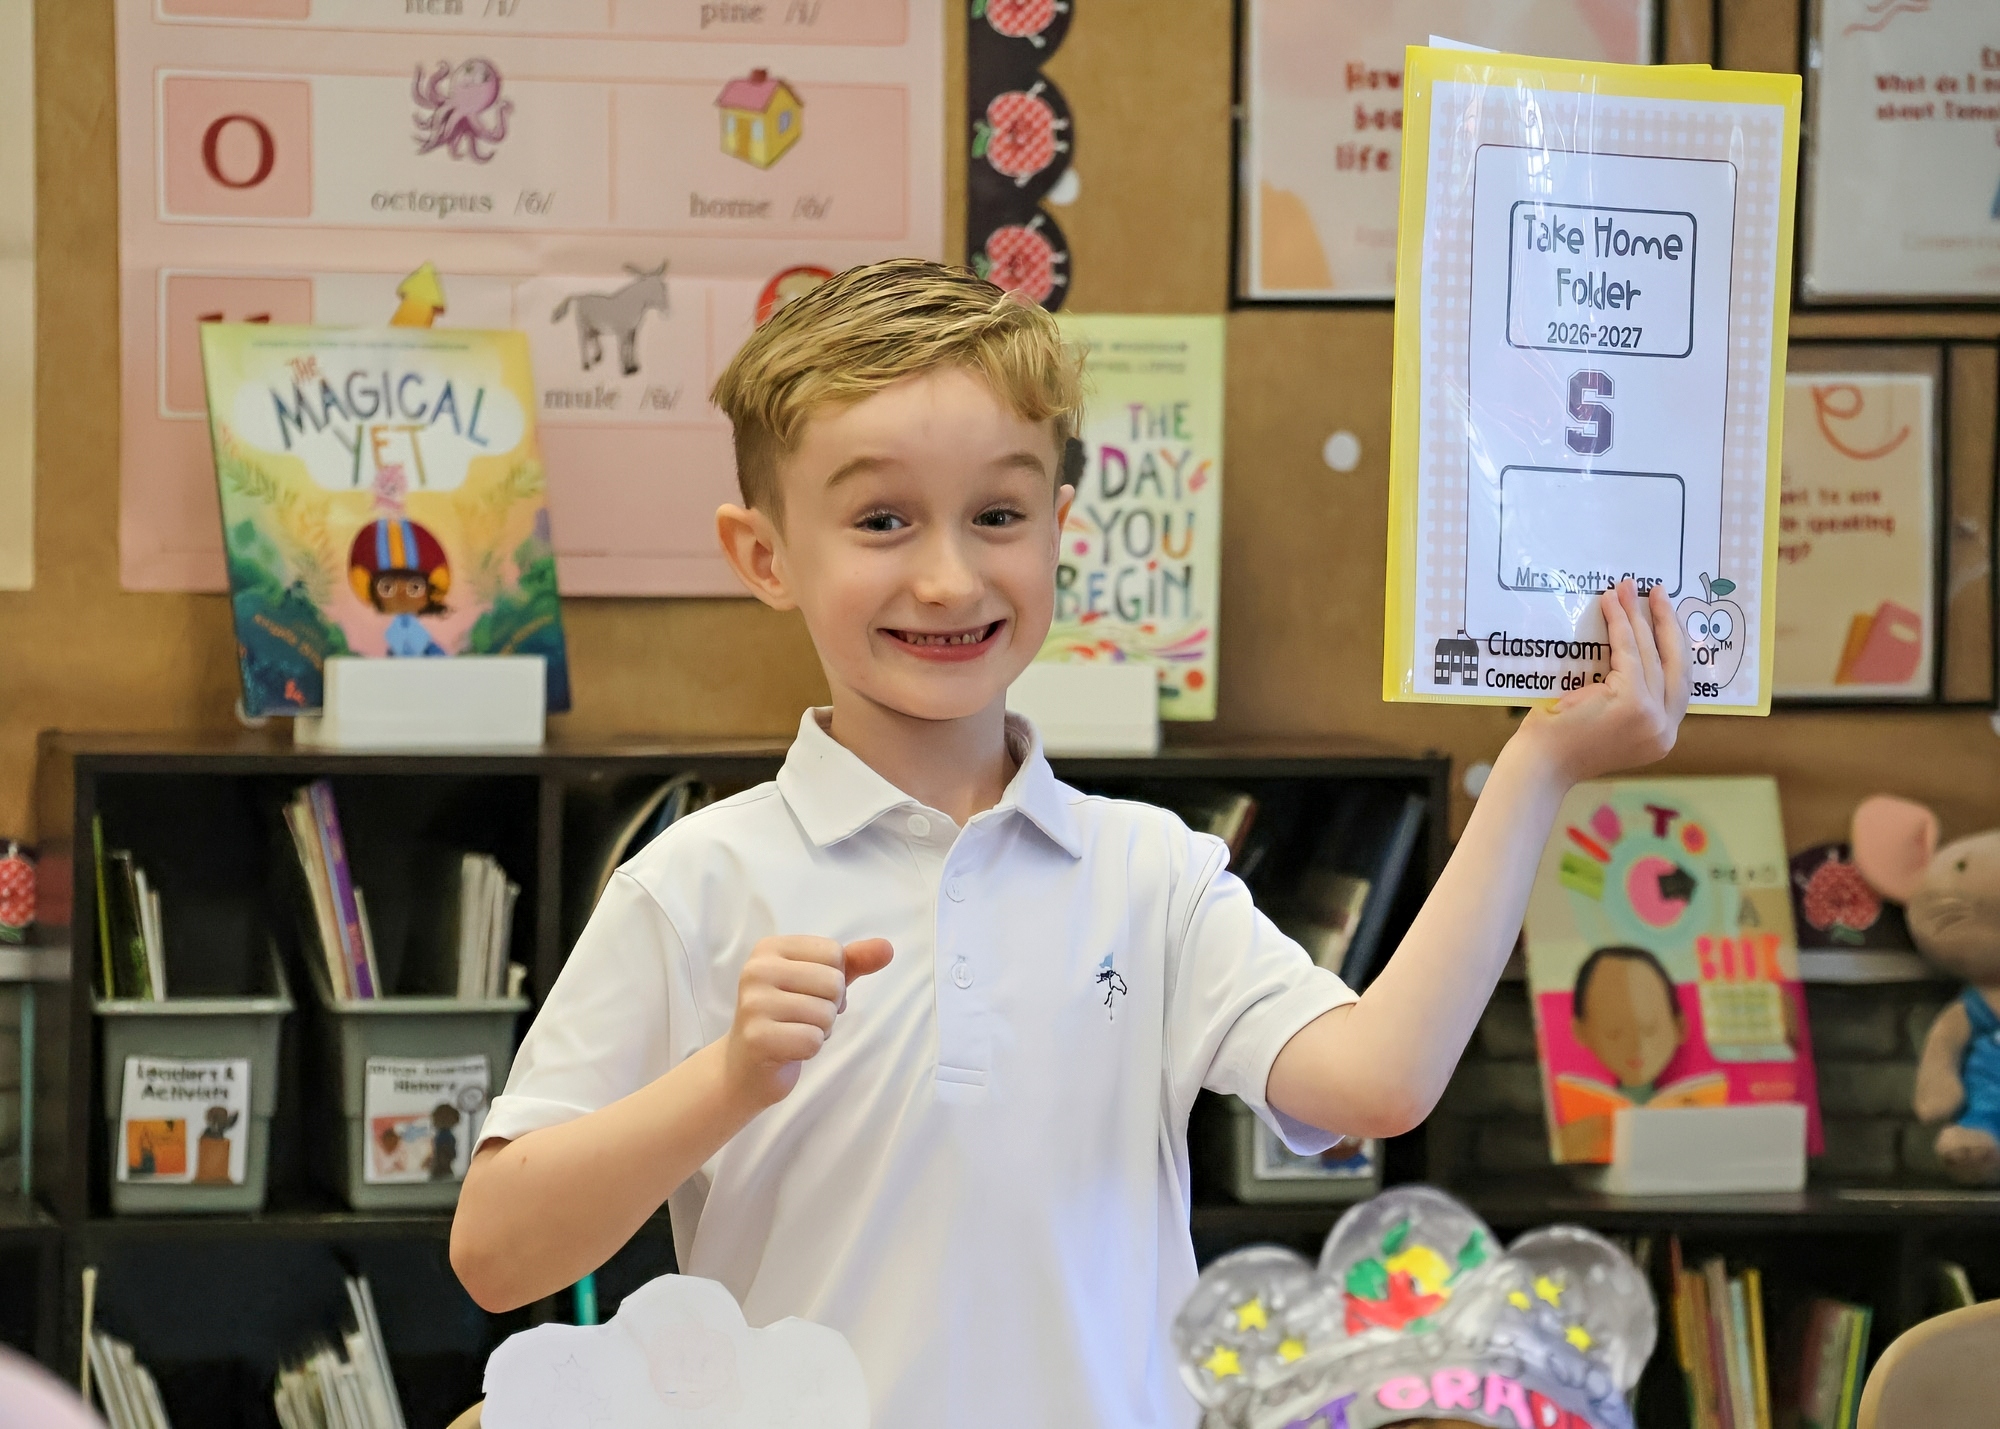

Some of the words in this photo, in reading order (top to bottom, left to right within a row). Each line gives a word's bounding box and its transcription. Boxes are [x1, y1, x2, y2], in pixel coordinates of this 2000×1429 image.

[371, 191, 492, 219] octopus
[1523, 214, 1585, 254] Take
[1594, 216, 1684, 261] Home
[1556, 267, 1642, 311] Folder
[1547, 321, 1643, 348] 2026-2027
[270, 370, 490, 451] MAGICAL
[1127, 402, 1193, 442] THE
[1565, 368, 1615, 457] S
[331, 423, 427, 486] YET
[1099, 446, 1192, 502] DAY
[1084, 506, 1195, 566] YOU
[1515, 566, 1552, 588] Mrs.
[1558, 569, 1615, 590] ott's
[1488, 630, 1602, 660] Classroom
[1485, 668, 1556, 690] Conector
[1561, 670, 1586, 690] del
